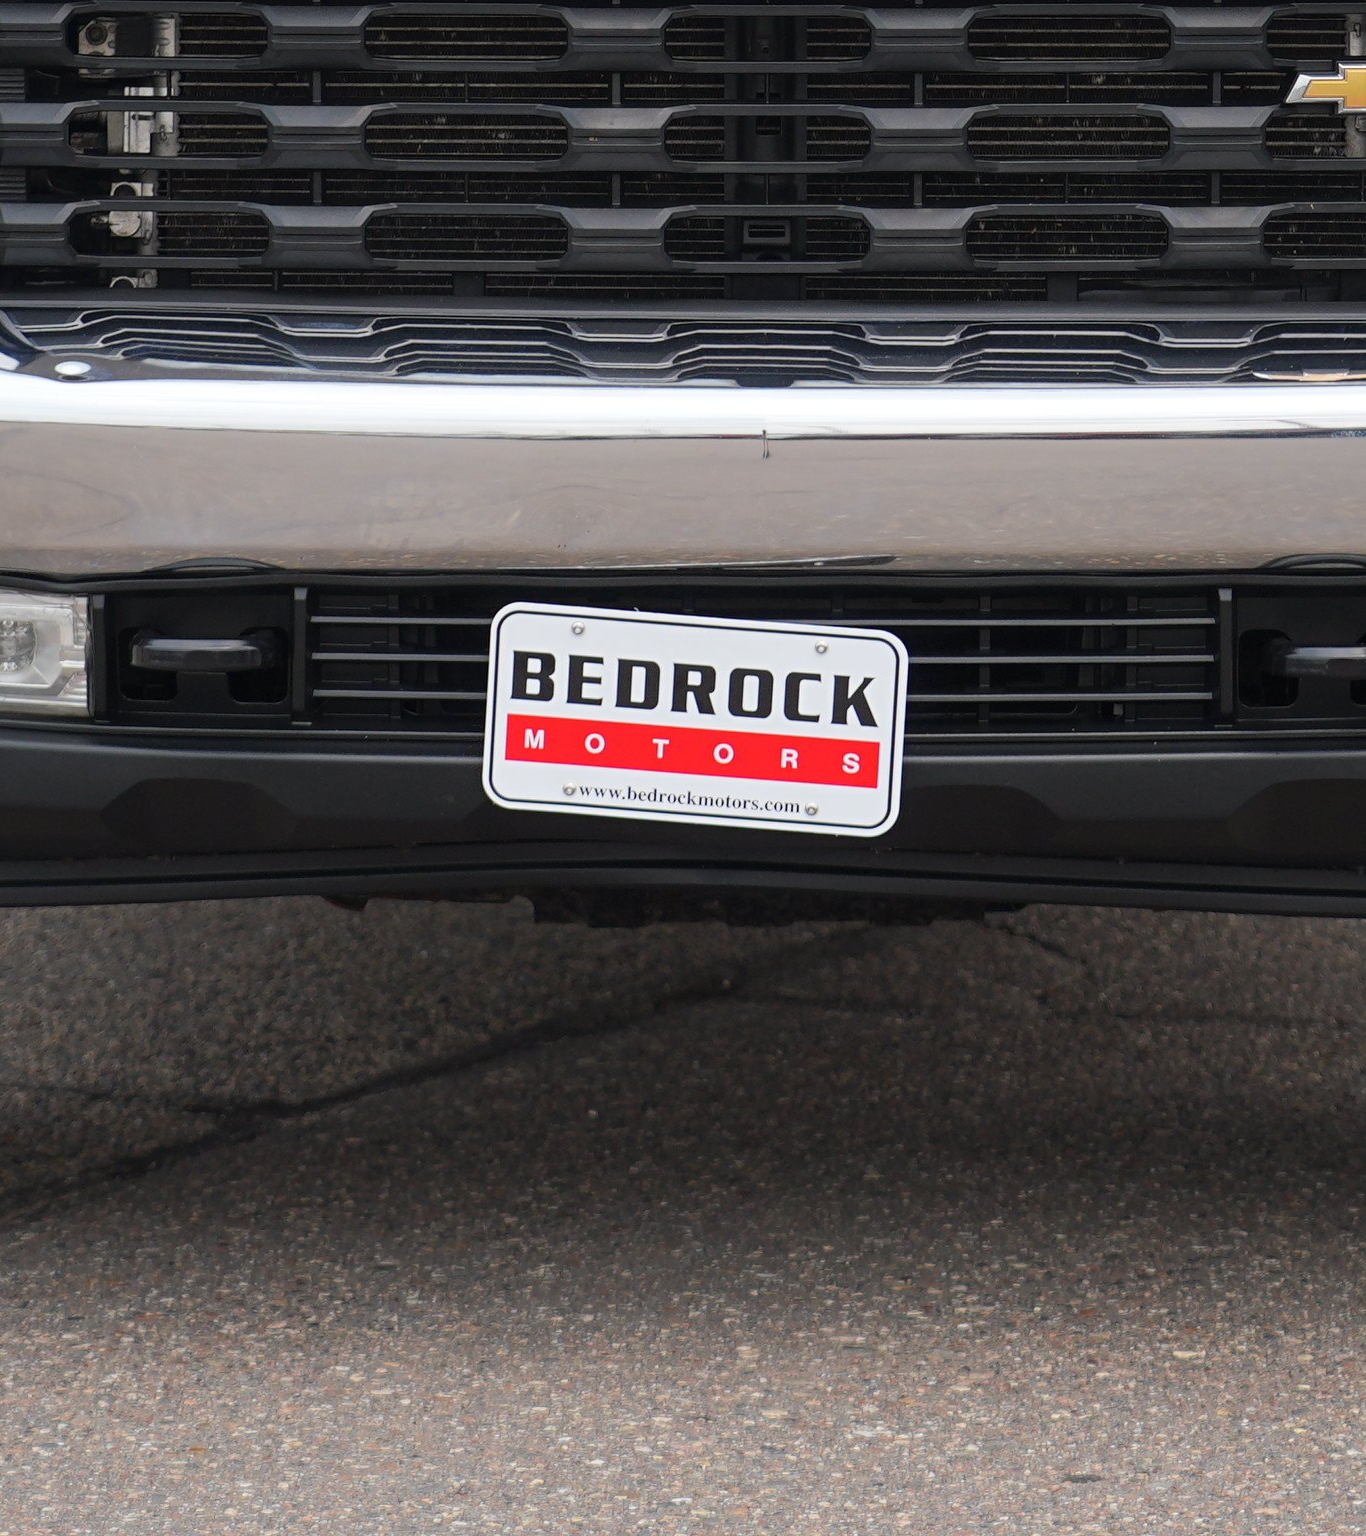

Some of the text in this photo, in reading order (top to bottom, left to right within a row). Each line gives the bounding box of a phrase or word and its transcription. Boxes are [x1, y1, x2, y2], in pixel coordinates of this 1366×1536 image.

[510, 650, 879, 728] BEDROCK
[523, 727, 862, 776] MOTORS
[579, 785, 801, 815] www.bedrockmotors.com
